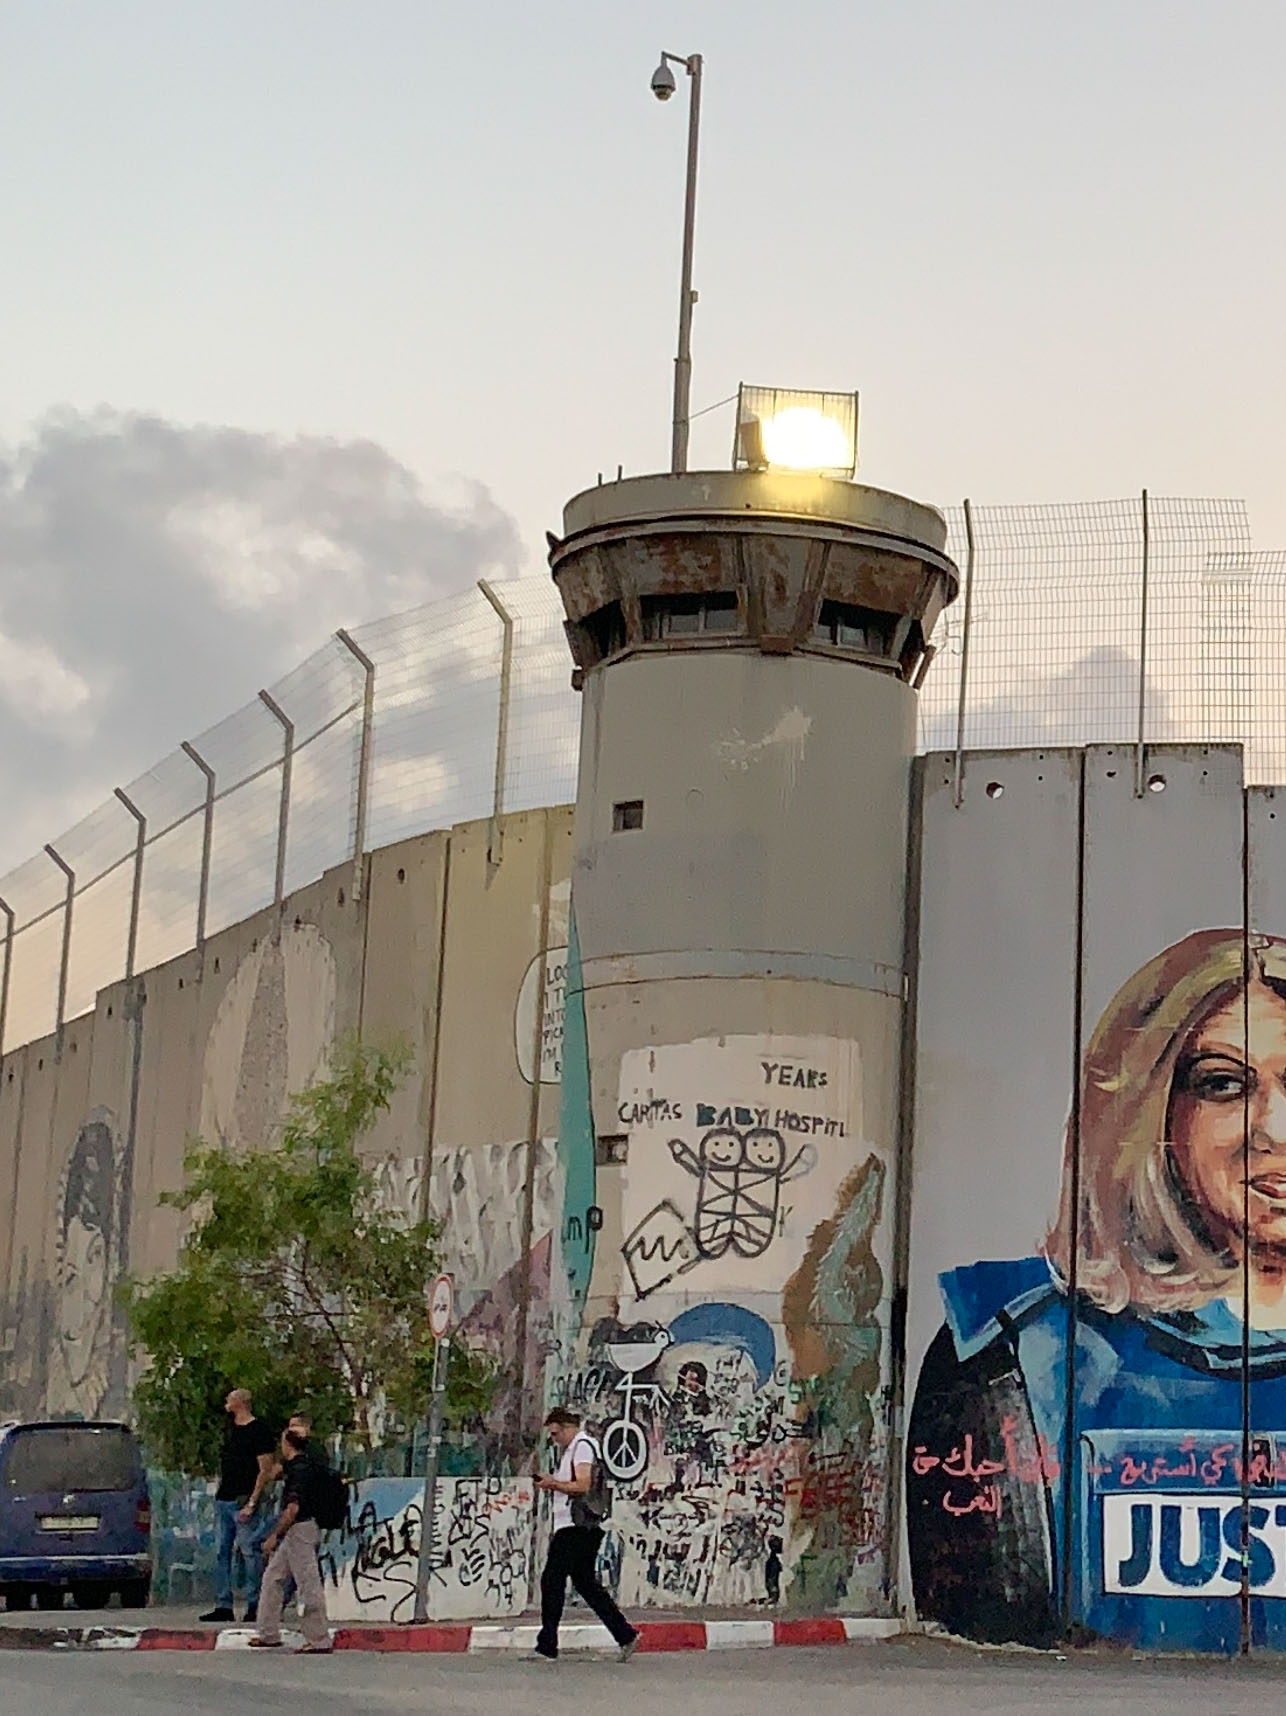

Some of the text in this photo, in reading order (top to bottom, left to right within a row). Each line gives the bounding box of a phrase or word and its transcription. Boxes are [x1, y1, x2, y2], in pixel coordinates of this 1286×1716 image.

[761, 1062, 828, 1089] YEARS
[618, 1101, 682, 1123] CARITAS
[696, 1103, 769, 1127] BABY
